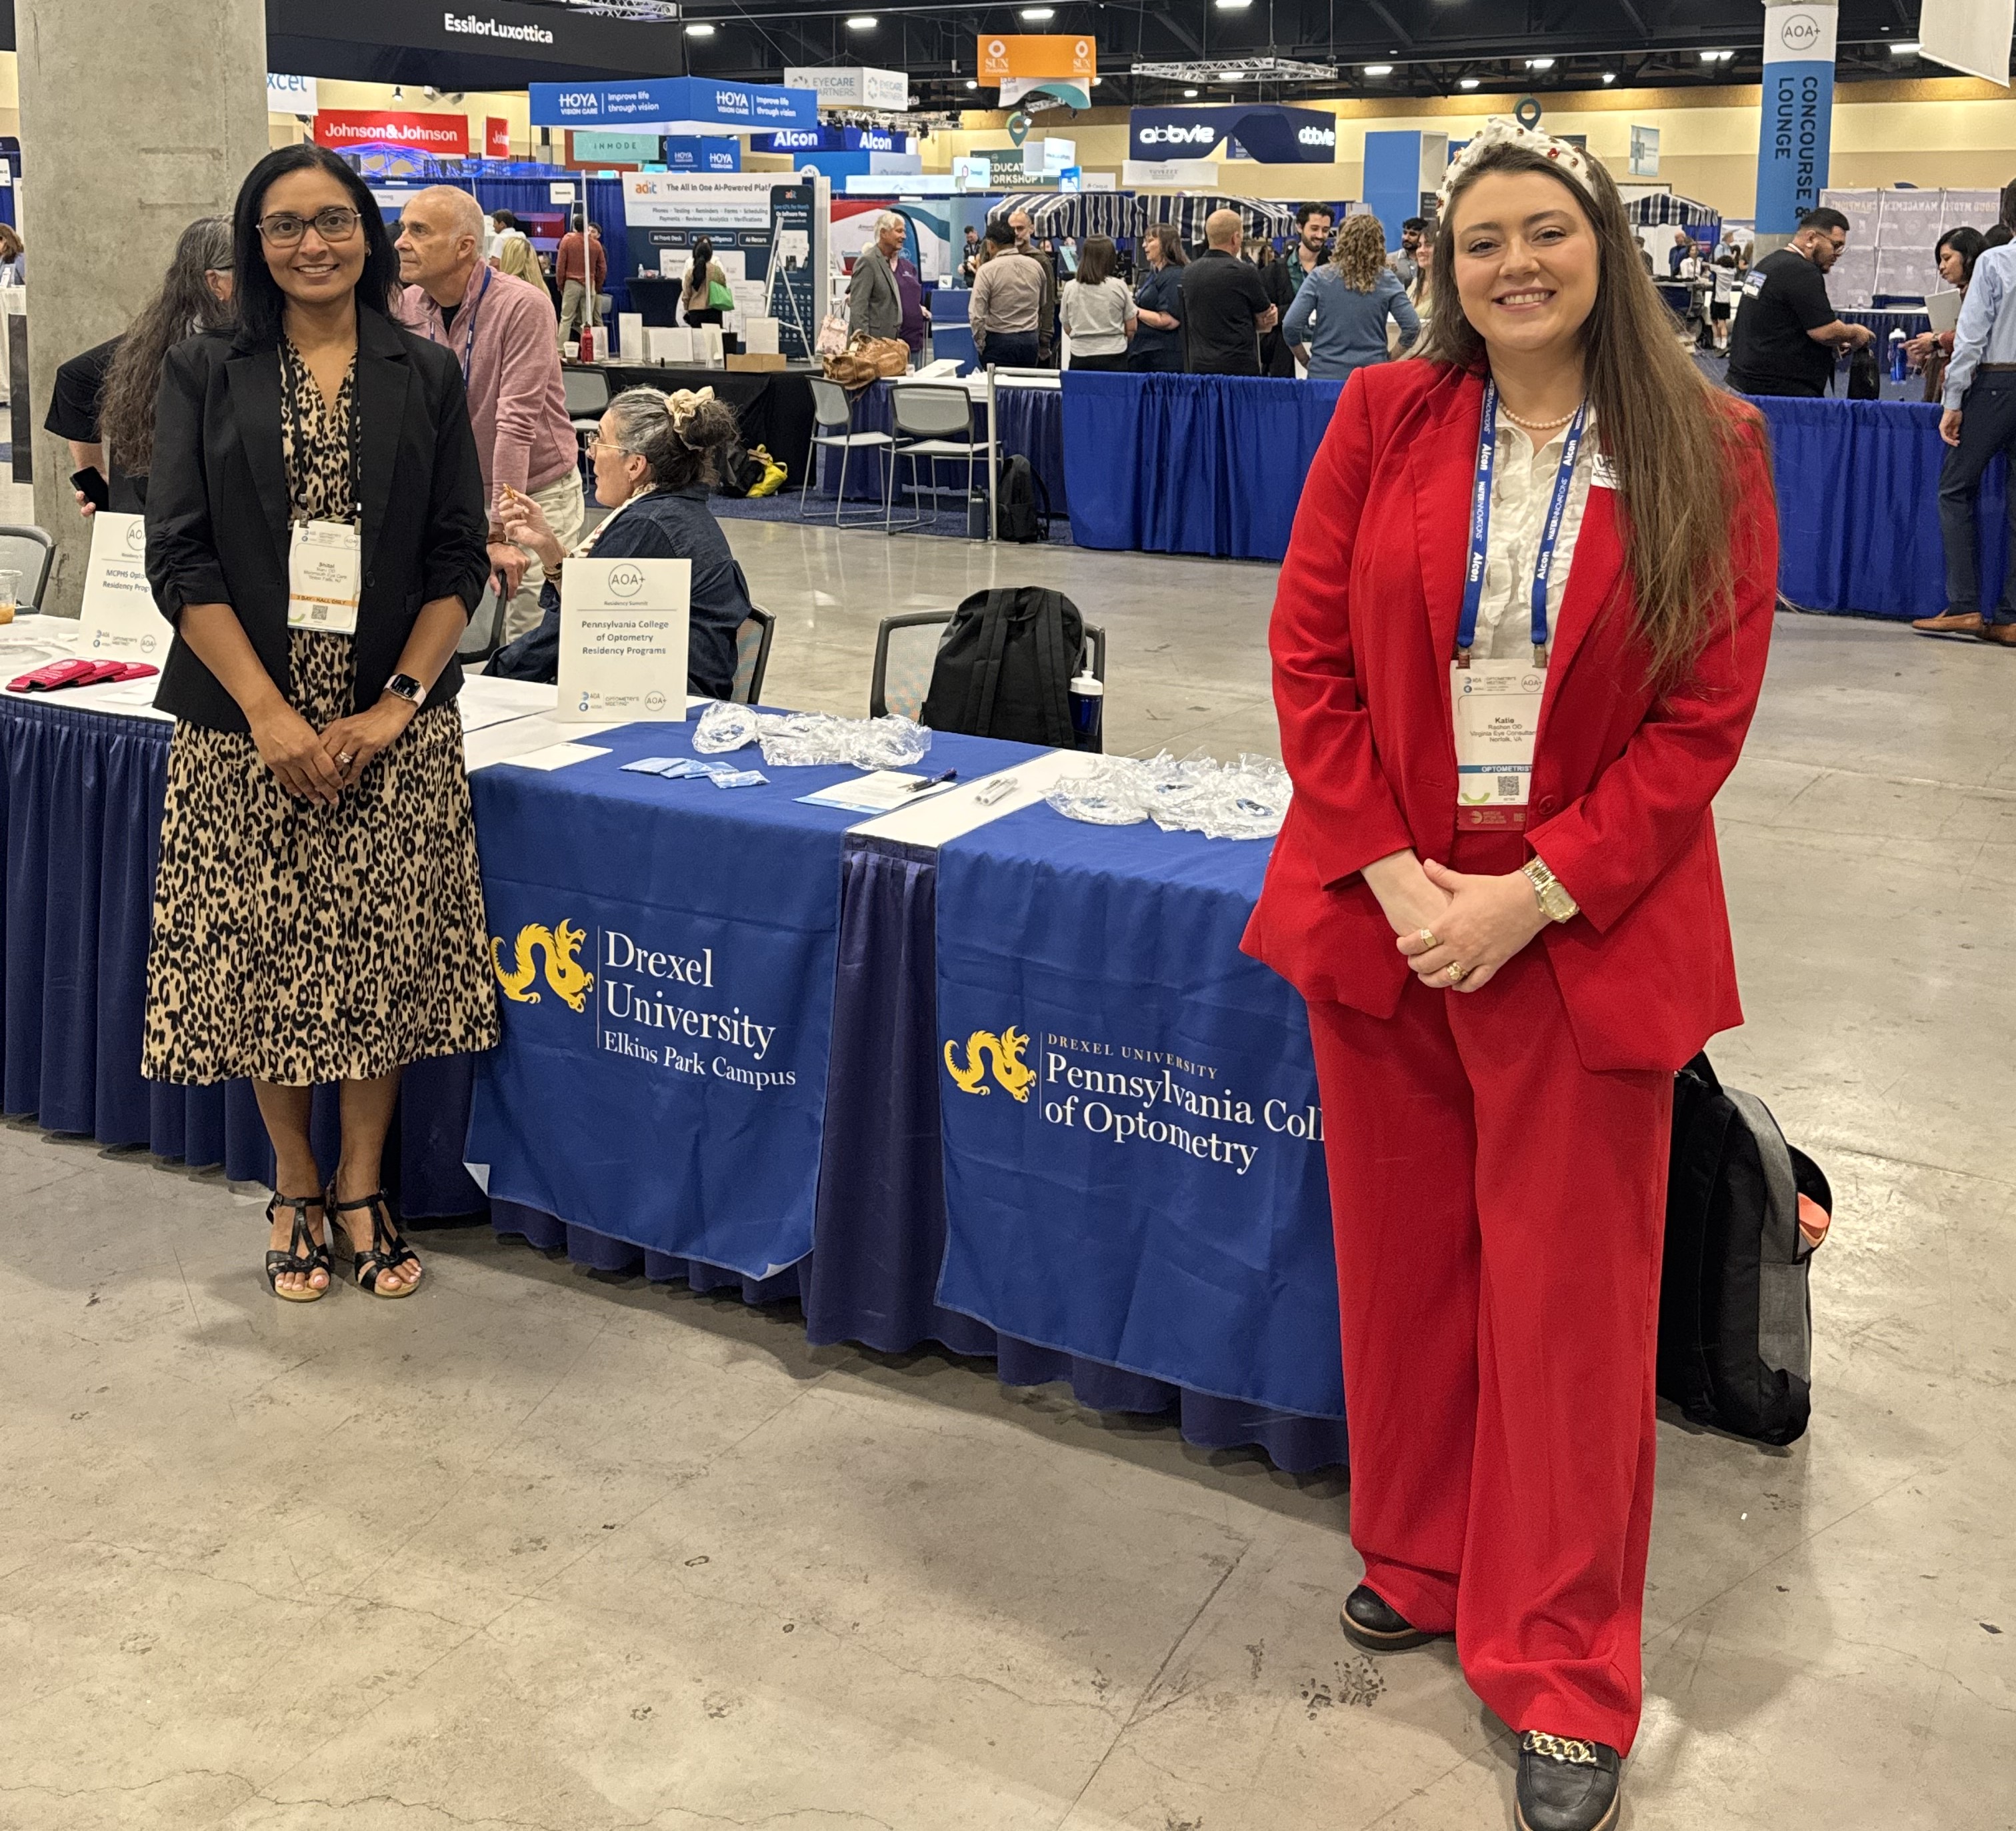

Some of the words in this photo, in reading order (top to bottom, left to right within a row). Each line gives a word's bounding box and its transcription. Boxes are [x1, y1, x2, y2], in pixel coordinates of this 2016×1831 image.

[444, 13, 553, 43] EssilorLuxottica
[985, 58, 1009, 68] SUN
[1073, 58, 1091, 69] SUN
[813, 77, 855, 87] EYECARE
[879, 79, 903, 91] EYECARE
[608, 93, 637, 101] Improve
[638, 91, 650, 100] life
[716, 91, 749, 107] HOYA
[817, 87, 857, 97] ARTNERS.
[559, 93, 598, 107] HOYA
[638, 102, 659, 111] vision
[756, 95, 779, 105] Improve
[780, 97, 789, 106] life
[756, 107, 779, 117] through
[1775, 77, 1795, 159] LOUNGE
[325, 123, 457, 142] Johnson&Johnson
[773, 131, 818, 147] Alcon
[1139, 124, 1214, 143] abbvie
[1298, 125, 1335, 146] abbvie
[1795, 76, 1818, 200] CONCOURSE
[594, 141, 637, 150] INMODE
[859, 131, 892, 150] Alcon
[709, 153, 733, 165] HOYA
[990, 175, 1037, 184] ORKSHOP
[635, 180, 657, 194] adit
[667, 183, 679, 192] The
[681, 183, 689, 192] All
[1480, 443, 1492, 471] Alcon
[1563, 439, 1577, 467] Alcon
[1470, 552, 1484, 583] Alcon
[1537, 551, 1550, 580] Alcon
[106, 569, 128, 578] MCPHS
[611, 573, 646, 585] AOA+
[103, 581, 133, 591] Residency
[581, 621, 637, 631] Pennsylvania
[638, 620, 669, 631] College
[607, 634, 653, 643] Optometry
[582, 647, 625, 656] Residency
[627, 647, 666, 657] Programs
[605, 930, 714, 988] Drexel
[604, 980, 776, 1060] University
[604, 1030, 658, 1064] Elkins
[663, 1046, 706, 1075] Park
[712, 1056, 797, 1091] Campus
[1048, 1032, 1114, 1057] DREXEL
[1121, 1046, 1218, 1080] UNIVERSITY
[1045, 1051, 1255, 1125] Pennsylvania
[1045, 1095, 1079, 1127] of
[1083, 1100, 1259, 1175] Optometry
